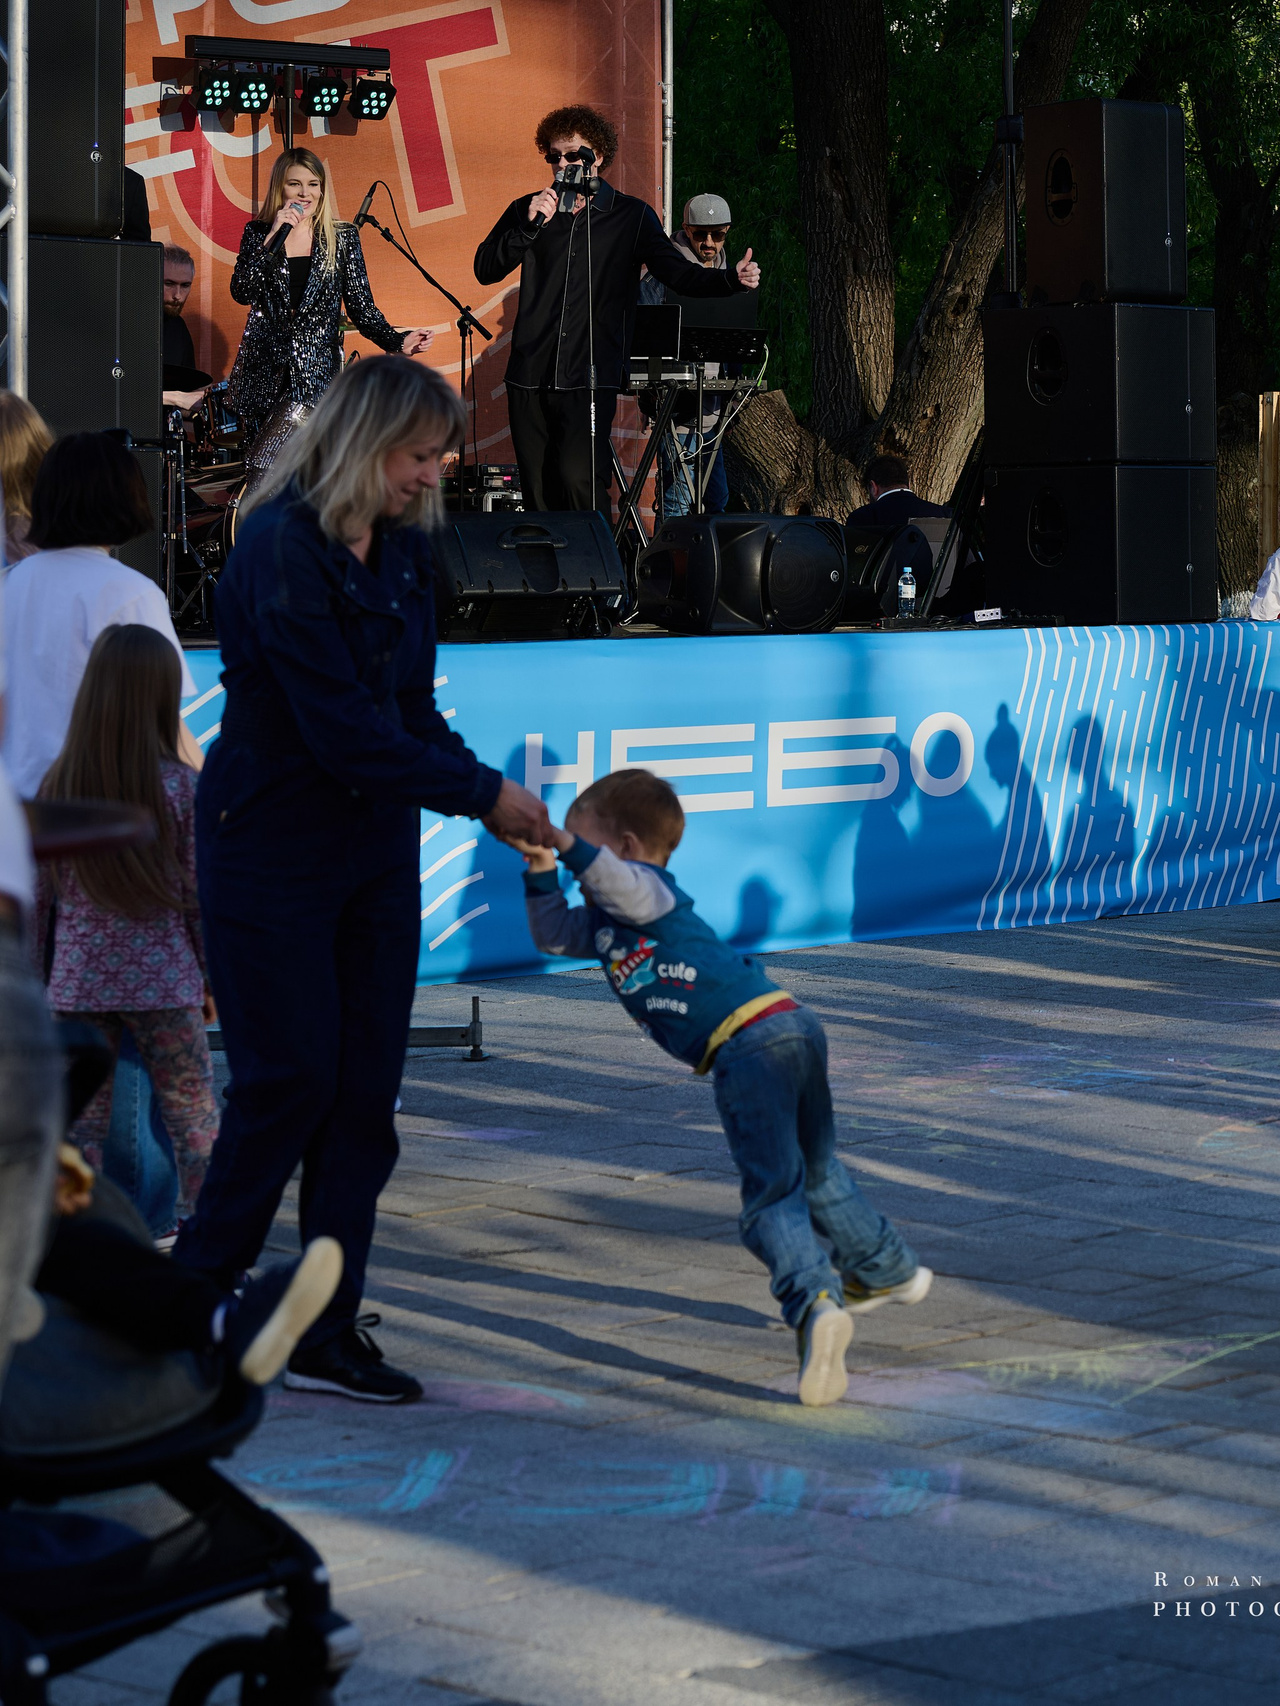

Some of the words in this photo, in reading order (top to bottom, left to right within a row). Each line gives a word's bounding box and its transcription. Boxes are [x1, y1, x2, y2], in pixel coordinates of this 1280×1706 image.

[525, 711, 975, 814] НЕБО
[657, 961, 698, 983] cute
[645, 994, 689, 1015] planes
